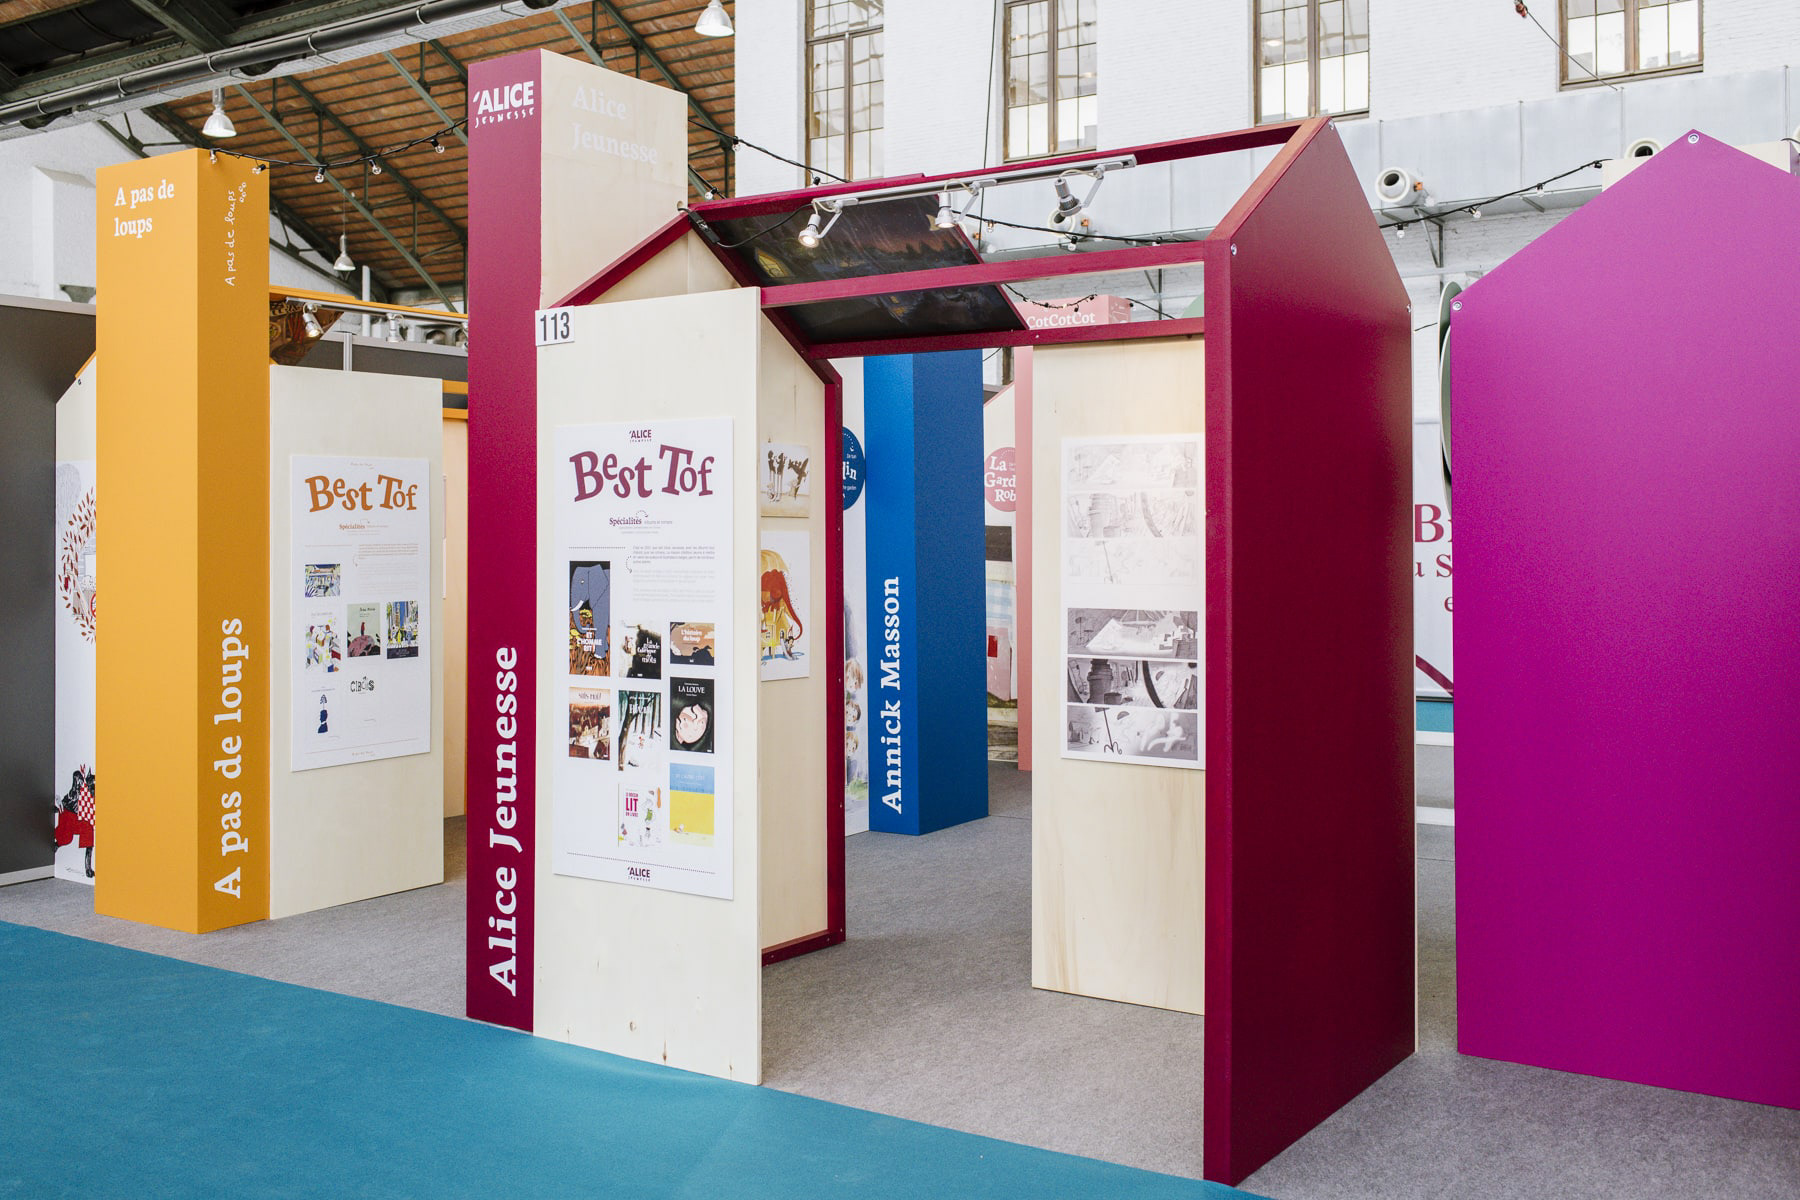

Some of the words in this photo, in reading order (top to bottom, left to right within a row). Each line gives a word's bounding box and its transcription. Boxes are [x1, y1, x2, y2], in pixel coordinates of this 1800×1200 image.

[572, 85, 627, 120] Alice
[570, 121, 658, 165] Jeunesse
[114, 186, 127, 207] A
[130, 185, 154, 209] pas
[157, 179, 175, 200] de
[224, 190, 237, 225] loups
[114, 216, 153, 239] loups
[225, 229, 235, 248] de
[227, 251, 236, 272] pas
[224, 276, 235, 286] A
[539, 311, 570, 342] 113
[1027, 312, 1096, 329] CotCotCot
[569, 450, 653, 503] Best
[658, 444, 715, 497] Tof
[988, 455, 1007, 471] La
[304, 474, 373, 513] Best
[377, 474, 418, 511] Tof
[609, 517, 642, 526] Spécialités
[880, 576, 900, 691] Masson
[214, 617, 249, 724] loups
[678, 685, 686, 693] LA
[686, 686, 705, 694] LOUVE
[214, 735, 242, 779] de
[489, 646, 523, 854] Jeunesse
[880, 699, 902, 815] Annick
[625, 797, 639, 812] LIT
[220, 790, 249, 856] pas
[214, 866, 241, 899] A
[488, 865, 517, 998] Alice
